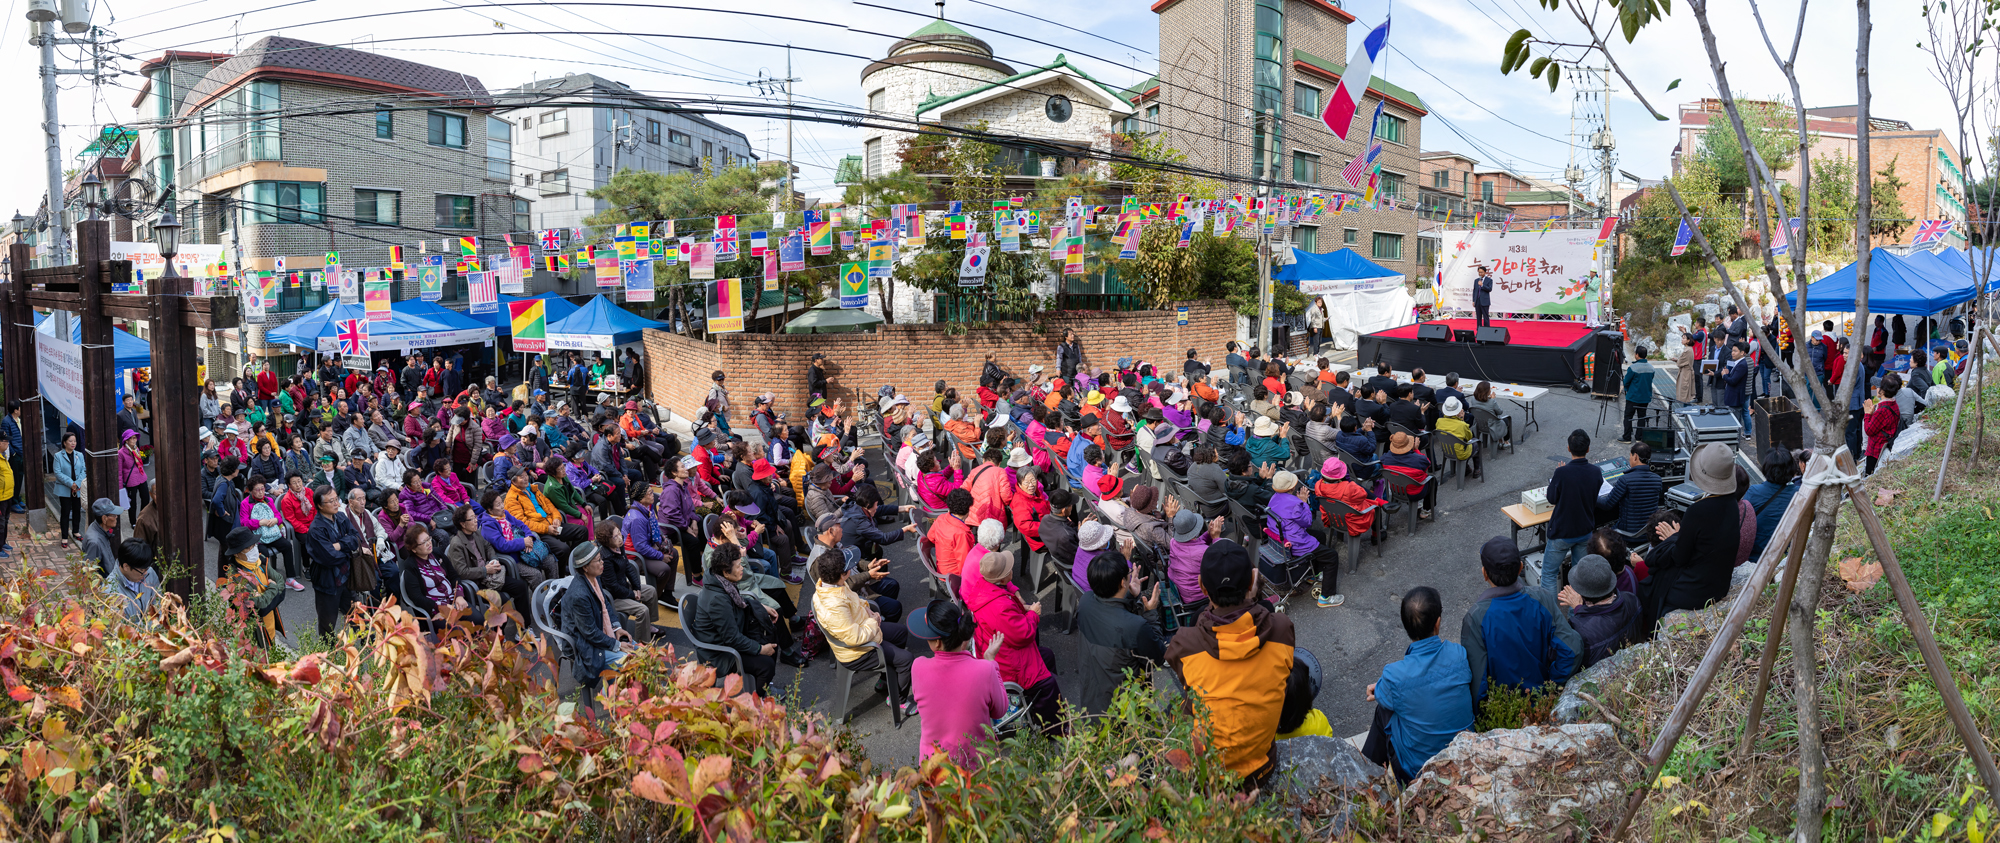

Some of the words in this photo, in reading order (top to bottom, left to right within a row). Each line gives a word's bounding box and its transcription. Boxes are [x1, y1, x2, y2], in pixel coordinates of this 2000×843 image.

[1508, 245, 1528, 253] 제3회
[1491, 256, 1538, 277] 감마을
[1538, 257, 1563, 275] 축제
[1496, 277, 1542, 293] 한마당
